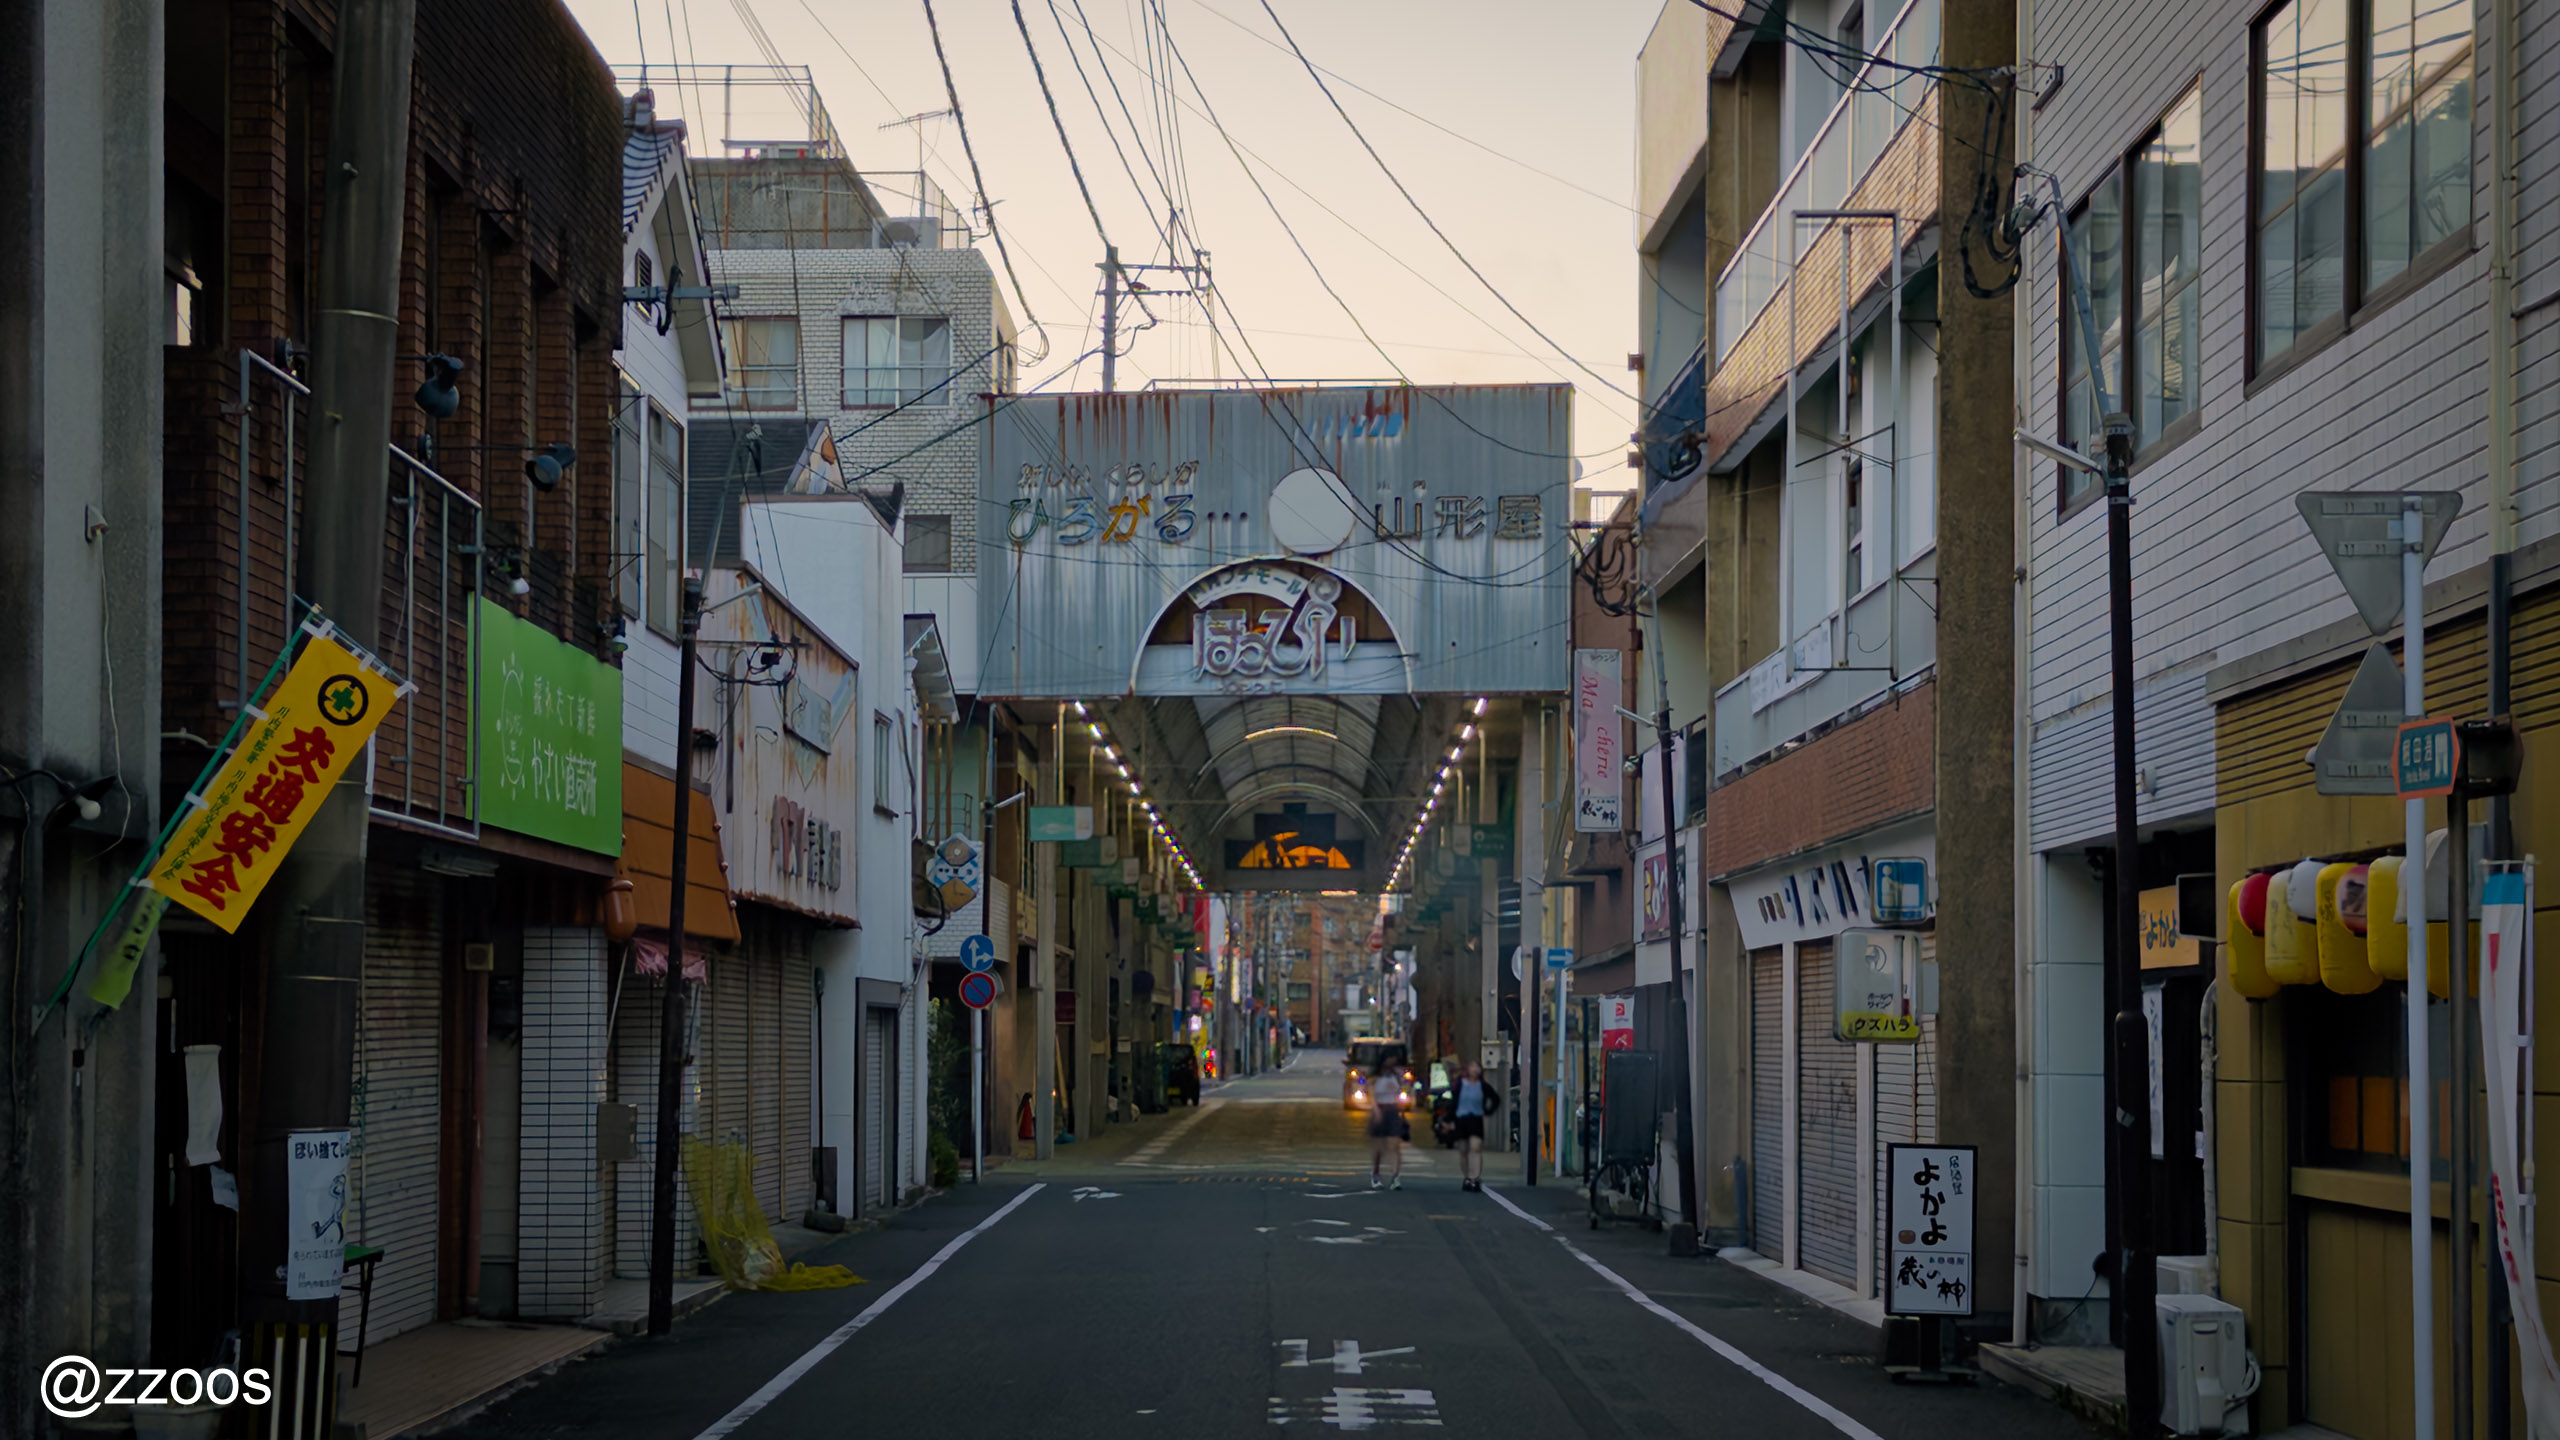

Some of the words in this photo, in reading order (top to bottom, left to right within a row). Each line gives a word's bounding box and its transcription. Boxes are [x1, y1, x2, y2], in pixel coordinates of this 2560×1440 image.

[1375, 494, 1542, 540] 山形屋
[1581, 674, 1601, 710] Ma
[531, 737, 597, 818] やさい直売所
[180, 724, 335, 911] 交通安全
[1854, 1017, 1910, 1032] クズハラ
[1913, 1157, 1948, 1246] よかよ
